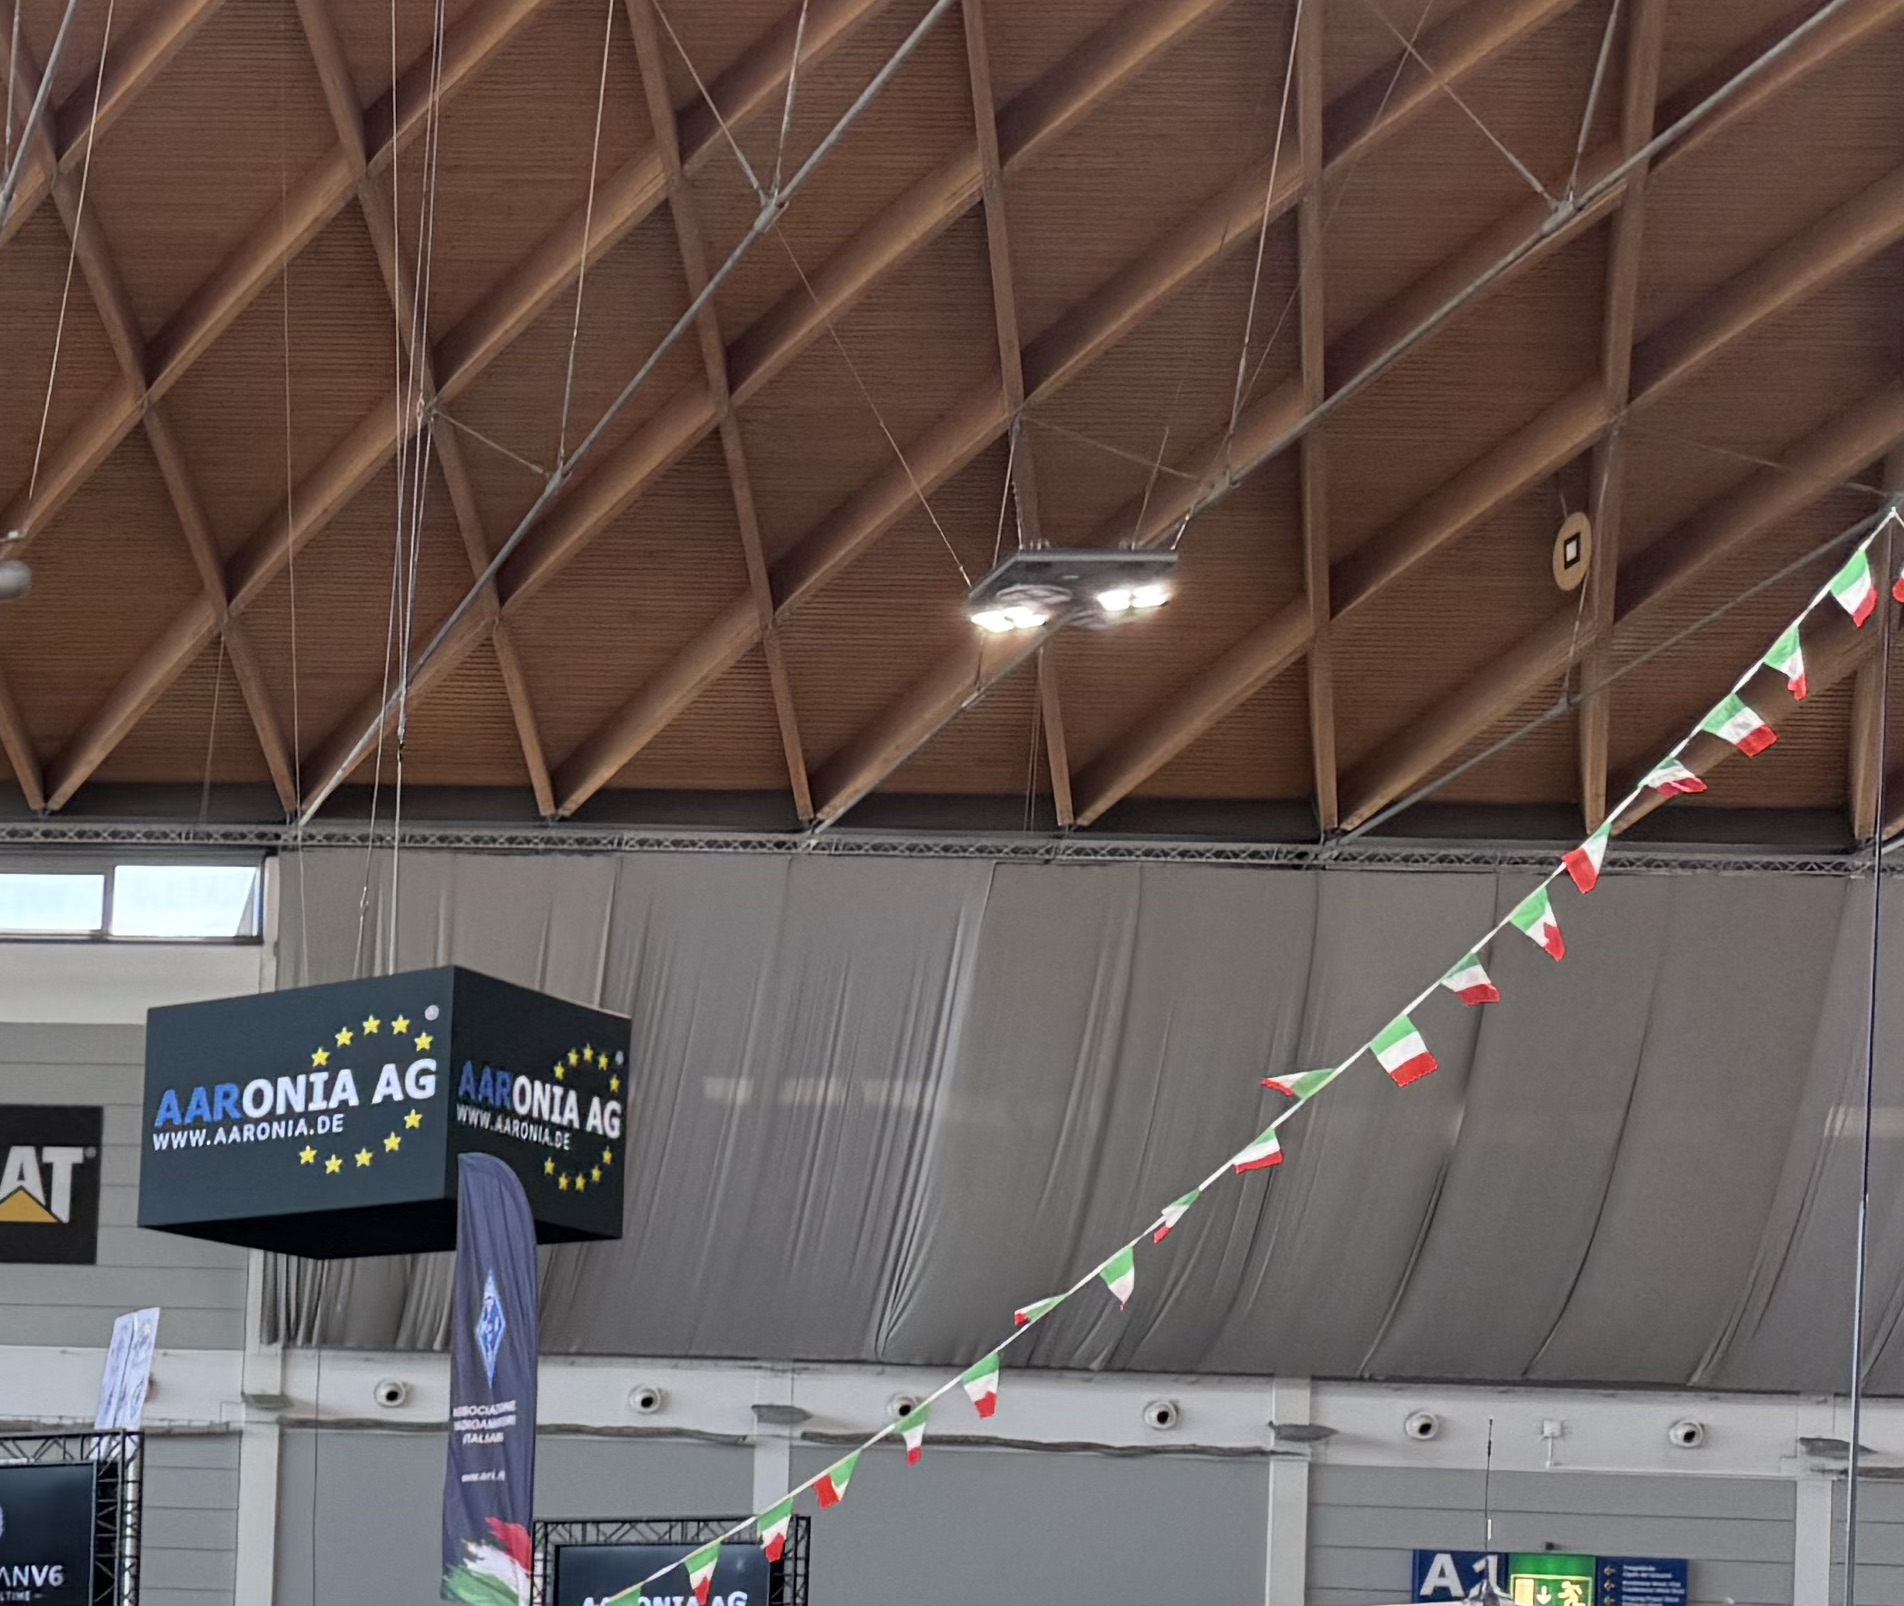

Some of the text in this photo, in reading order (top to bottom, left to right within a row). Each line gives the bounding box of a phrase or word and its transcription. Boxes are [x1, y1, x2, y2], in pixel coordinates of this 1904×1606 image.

[154, 1058, 438, 1127] AARONIA AG
[458, 1060, 622, 1139] AARONIA AG
[152, 1113, 344, 1152] WWW.AARONIA.DE
[456, 1102, 572, 1152] WWW.AARONIA.DE
